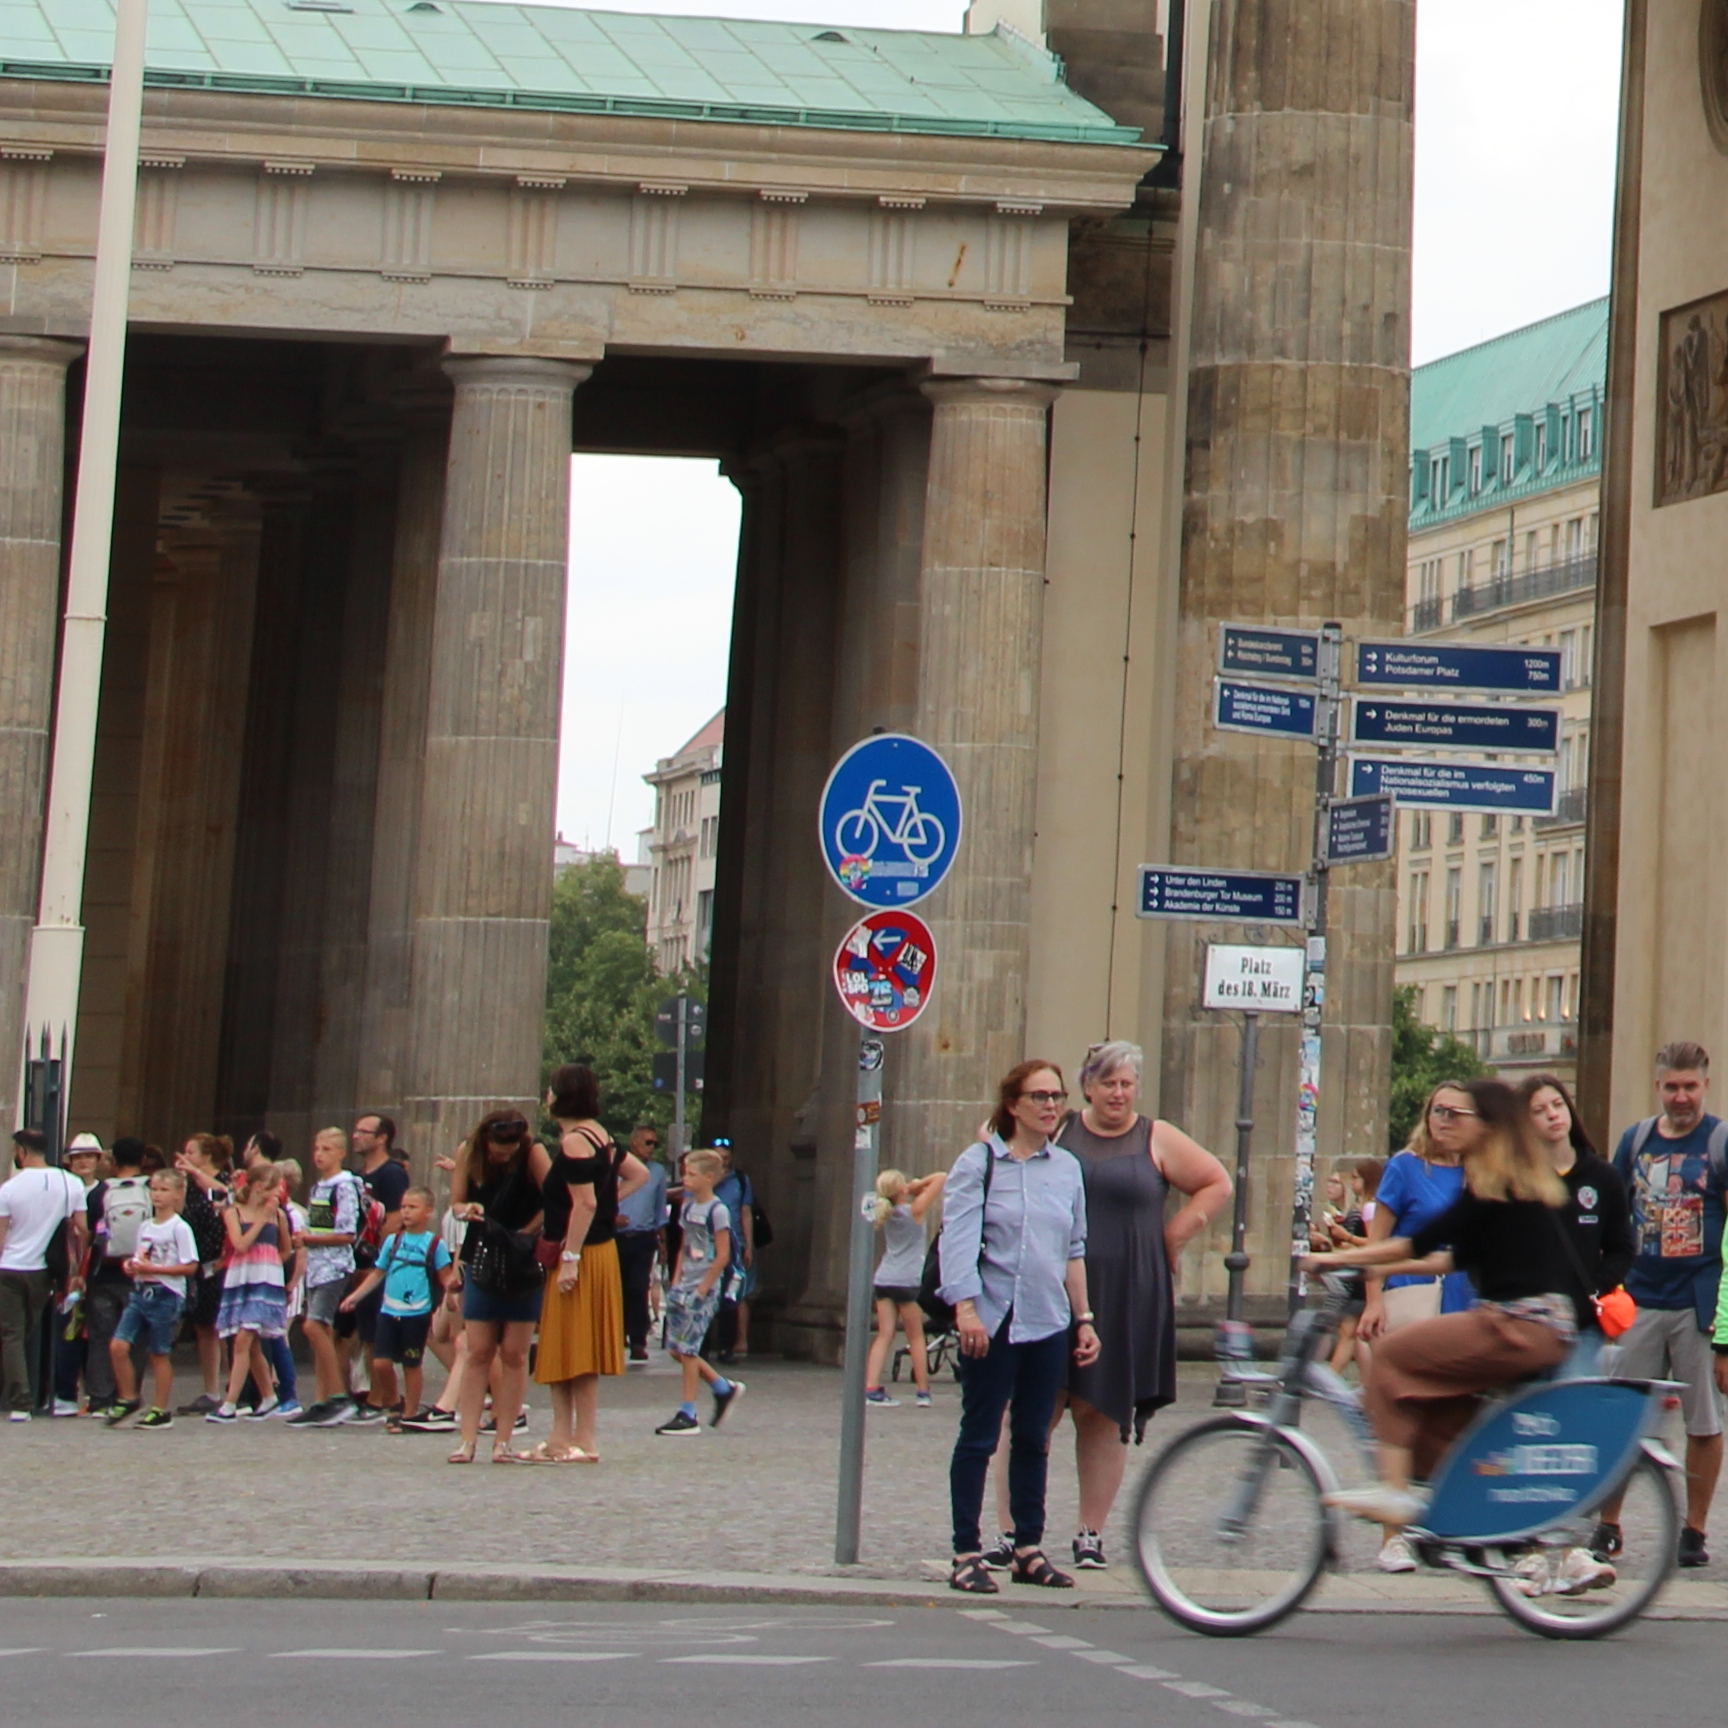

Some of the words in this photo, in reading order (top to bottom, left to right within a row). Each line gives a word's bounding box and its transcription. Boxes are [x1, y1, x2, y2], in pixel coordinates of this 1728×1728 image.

[1385, 652, 1439, 665] Kulturforum
[1524, 658, 1550, 669] 1200m
[1385, 664, 1435, 676] Potsdamer
[1437, 666, 1460, 677] Platz
[1385, 710, 1426, 722] Denkmal
[1427, 712, 1440, 723] für
[1441, 713, 1455, 723] die
[1457, 715, 1510, 726] ermordeten
[1384, 722, 1413, 733] Juden
[1415, 724, 1453, 736] Europas
[1381, 764, 1422, 777] Denkmal
[1423, 766, 1436, 778] für
[1437, 767, 1452, 779] die
[1453, 768, 1466, 779] im
[1380, 775, 1470, 790] Nationalsozialismus
[1471, 780, 1517, 792] verfolgten
[1165, 875, 1186, 886] Unter
[1187, 876, 1201, 886] den
[1202, 877, 1227, 888] Linden
[1165, 886, 1219, 901] Brandenburger
[1220, 890, 1232, 901] Tor
[1232, 891, 1263, 903] Museum
[1164, 899, 1201, 911] Akademie
[1201, 901, 1214, 912] der
[1215, 902, 1241, 913] Künste
[1241, 957, 1272, 975] Platz
[846, 971, 869, 983] LOL
[1218, 979, 1239, 997] des
[1241, 980, 1258, 998] 18.
[1260, 981, 1291, 999] März
